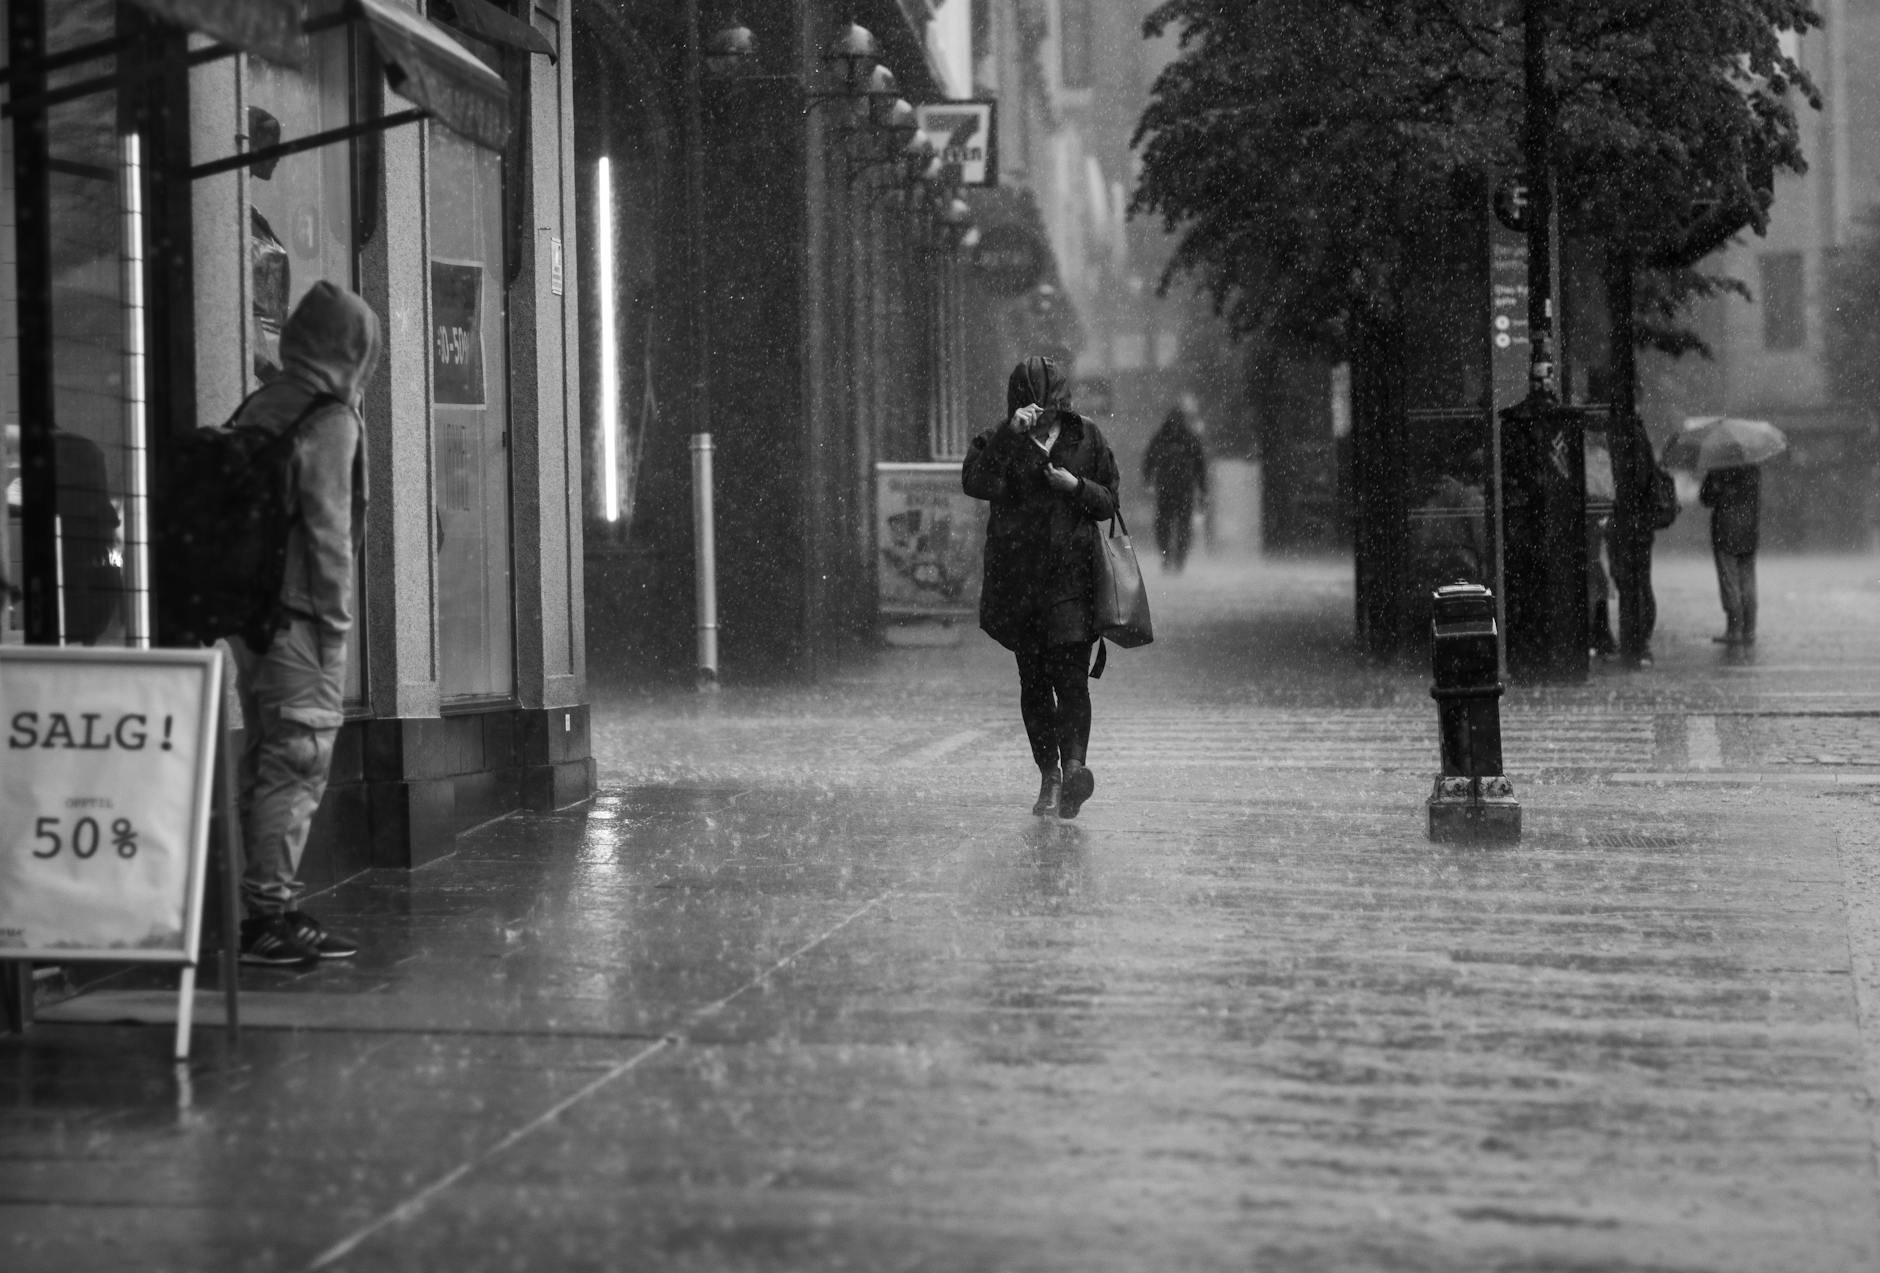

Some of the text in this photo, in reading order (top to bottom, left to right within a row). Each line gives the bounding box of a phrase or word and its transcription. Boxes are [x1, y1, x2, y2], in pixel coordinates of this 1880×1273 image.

[926, 112, 981, 180] 7
[9, 711, 173, 751] SALG!
[33, 816, 138, 859] 50%
